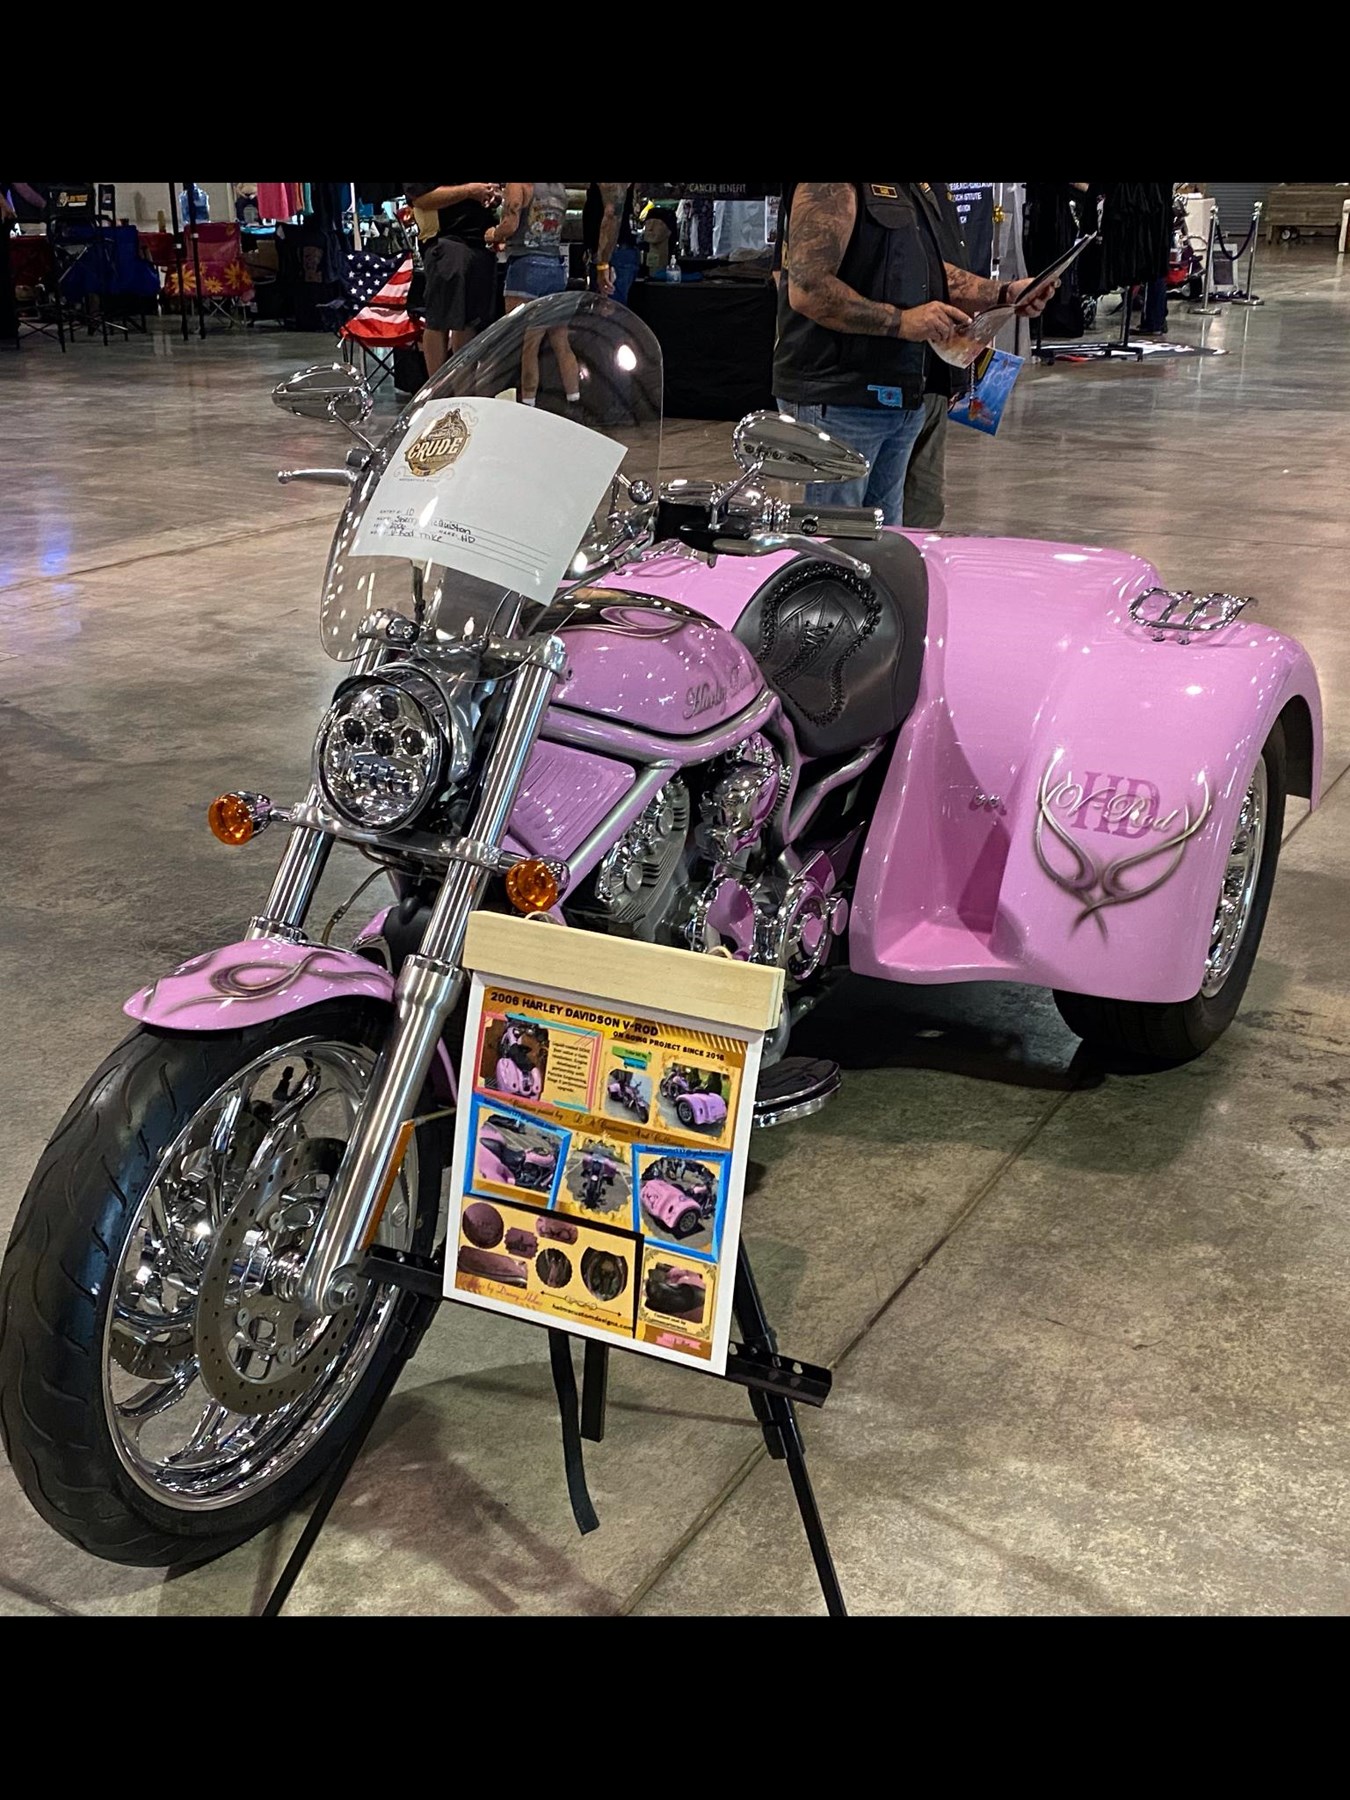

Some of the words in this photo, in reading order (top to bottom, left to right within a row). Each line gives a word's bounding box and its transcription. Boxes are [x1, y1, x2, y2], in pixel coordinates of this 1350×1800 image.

[688, 183, 717, 193] CANCER
[719, 183, 746, 193] BENEFIT
[407, 437, 464, 462] CRUDE
[1071, 771, 1161, 839] HD
[490, 991, 520, 1006] 2006
[522, 998, 564, 1016] HARLEY
[565, 1007, 620, 1028] DAVIDSON
[622, 1020, 659, 1036] V-ROD
[612, 1030, 624, 1039] ON
[624, 1032, 648, 1044] GOING
[649, 1038, 681, 1052] PROJECT
[682, 1046, 704, 1056] SINCE
